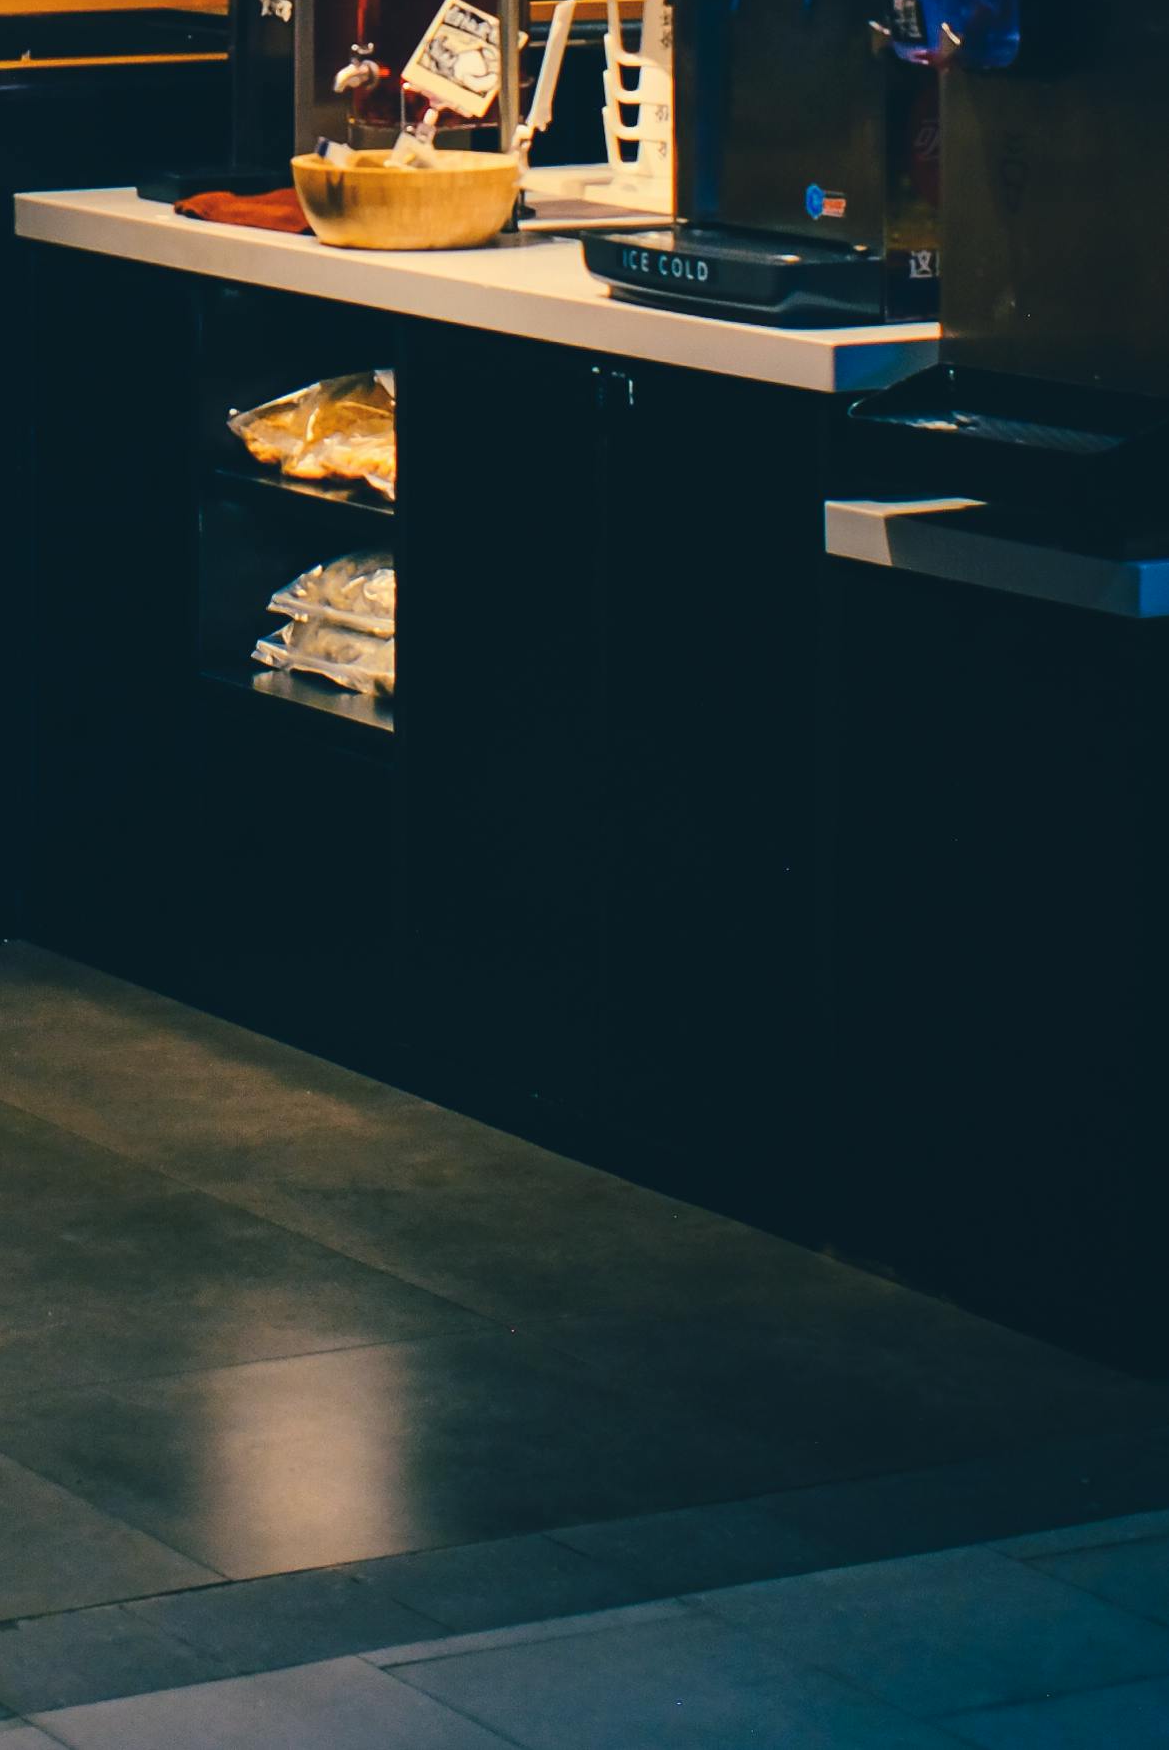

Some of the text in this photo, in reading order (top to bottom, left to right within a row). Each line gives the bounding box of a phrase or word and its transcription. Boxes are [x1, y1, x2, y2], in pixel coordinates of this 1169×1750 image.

[622, 249, 709, 282] ICE COLD
[909, 250, 939, 278] 这
